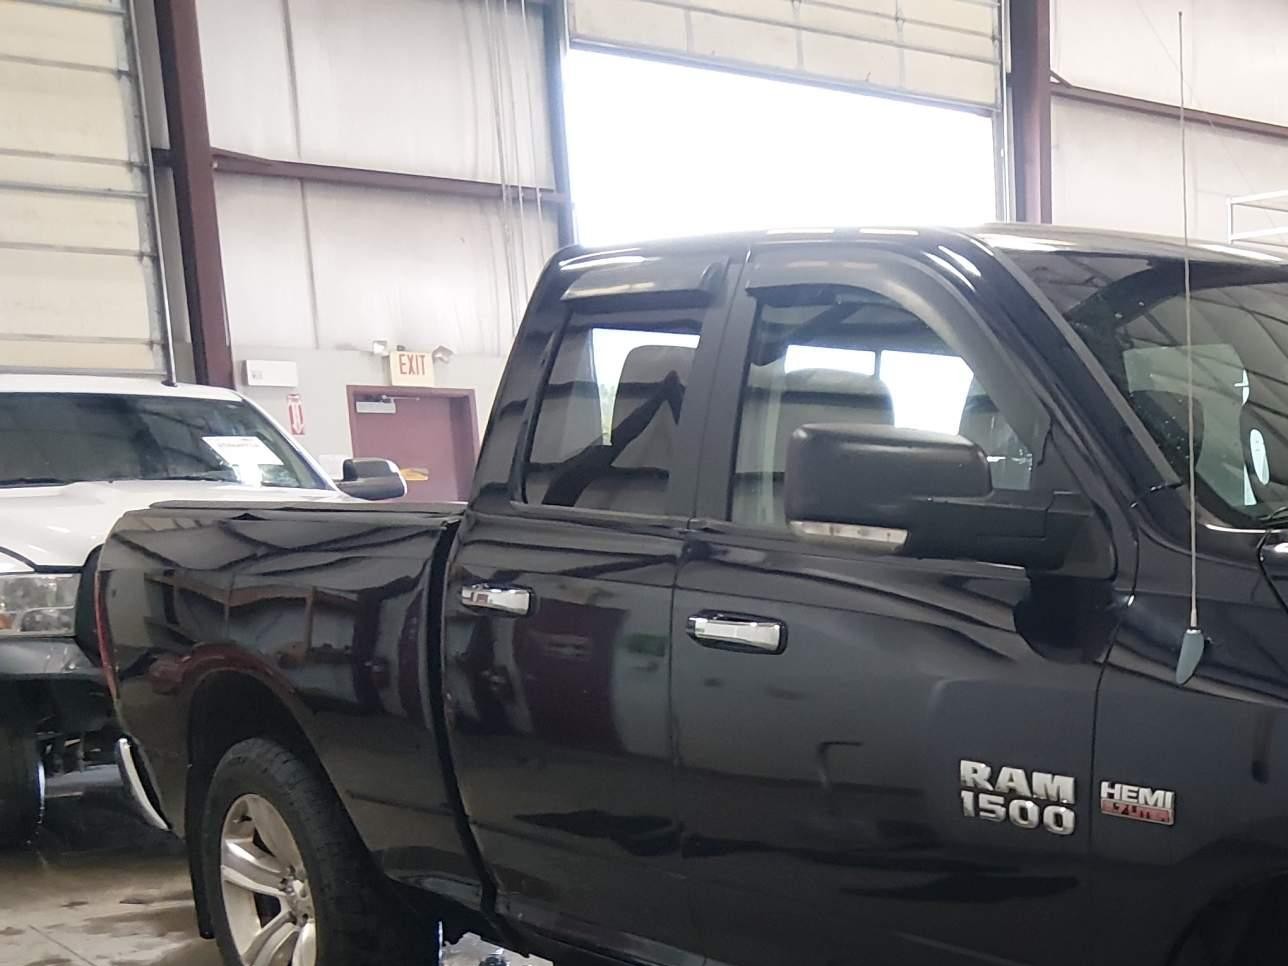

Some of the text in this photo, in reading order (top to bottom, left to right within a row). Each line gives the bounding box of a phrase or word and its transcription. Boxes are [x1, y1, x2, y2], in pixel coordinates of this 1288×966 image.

[399, 353, 425, 376] EXIT
[960, 759, 1075, 804] RAM
[1100, 781, 1175, 810] HEMI
[961, 790, 1075, 835] 1500
